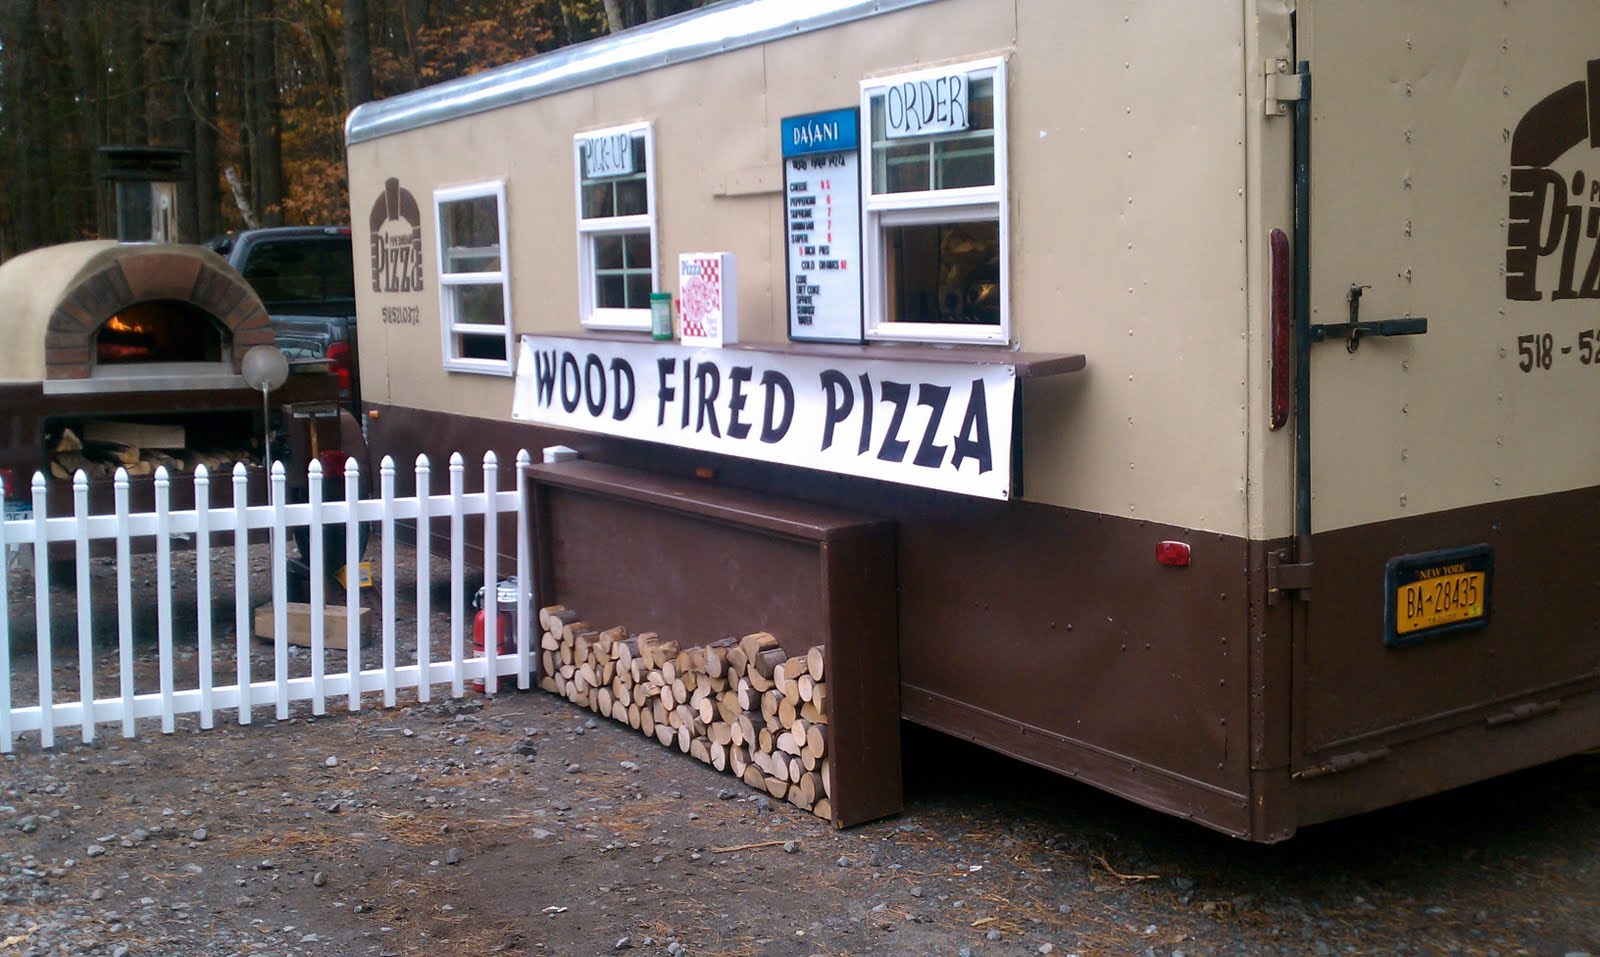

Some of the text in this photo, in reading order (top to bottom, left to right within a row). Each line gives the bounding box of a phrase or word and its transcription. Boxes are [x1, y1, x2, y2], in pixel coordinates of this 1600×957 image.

[888, 75, 965, 132] ORDER
[793, 120, 839, 147] DASANI
[585, 134, 627, 174] PICK-UP
[374, 231, 422, 292] Pizza
[801, 260, 815, 270] COLD
[819, 260, 839, 270] DRINKS
[534, 349, 993, 475] WOOD FIRED PIZZA
[1420, 563, 1465, 580] NEW YORK
